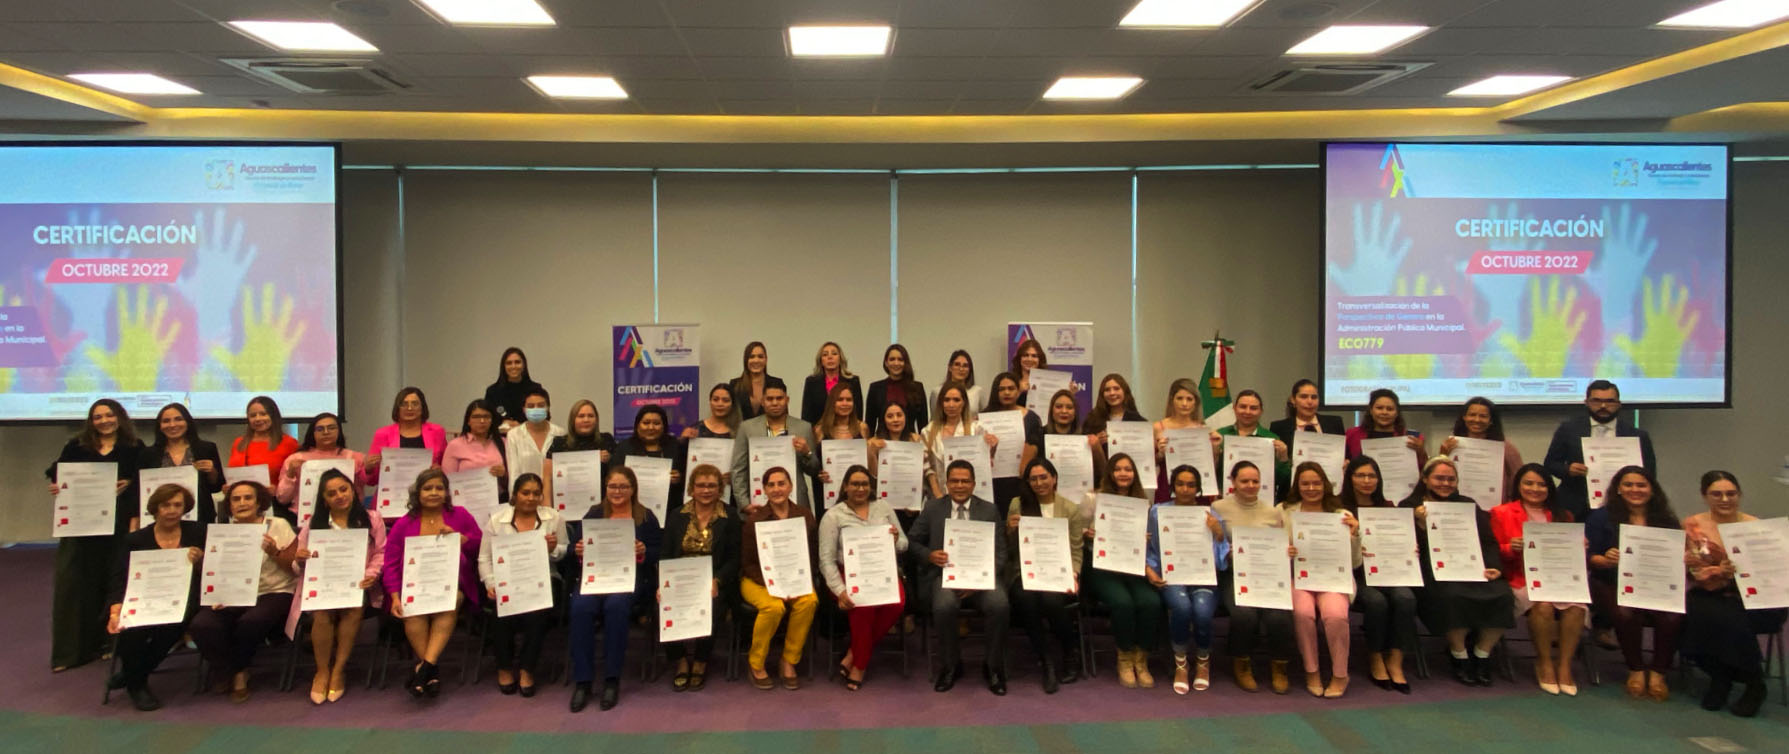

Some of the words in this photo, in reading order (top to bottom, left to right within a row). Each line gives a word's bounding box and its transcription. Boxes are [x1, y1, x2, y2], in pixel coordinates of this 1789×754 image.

[33, 219, 197, 245] CERTIFICACIÓN
[1455, 214, 1604, 238] CERTIFICACIÓN
[1481, 255, 1542, 268] OCTUBRE
[1544, 255, 1579, 268] 2022
[62, 263, 129, 277] OCTUBRE
[131, 262, 169, 276] 2022
[617, 382, 693, 395] CERTIFICACIÓN
